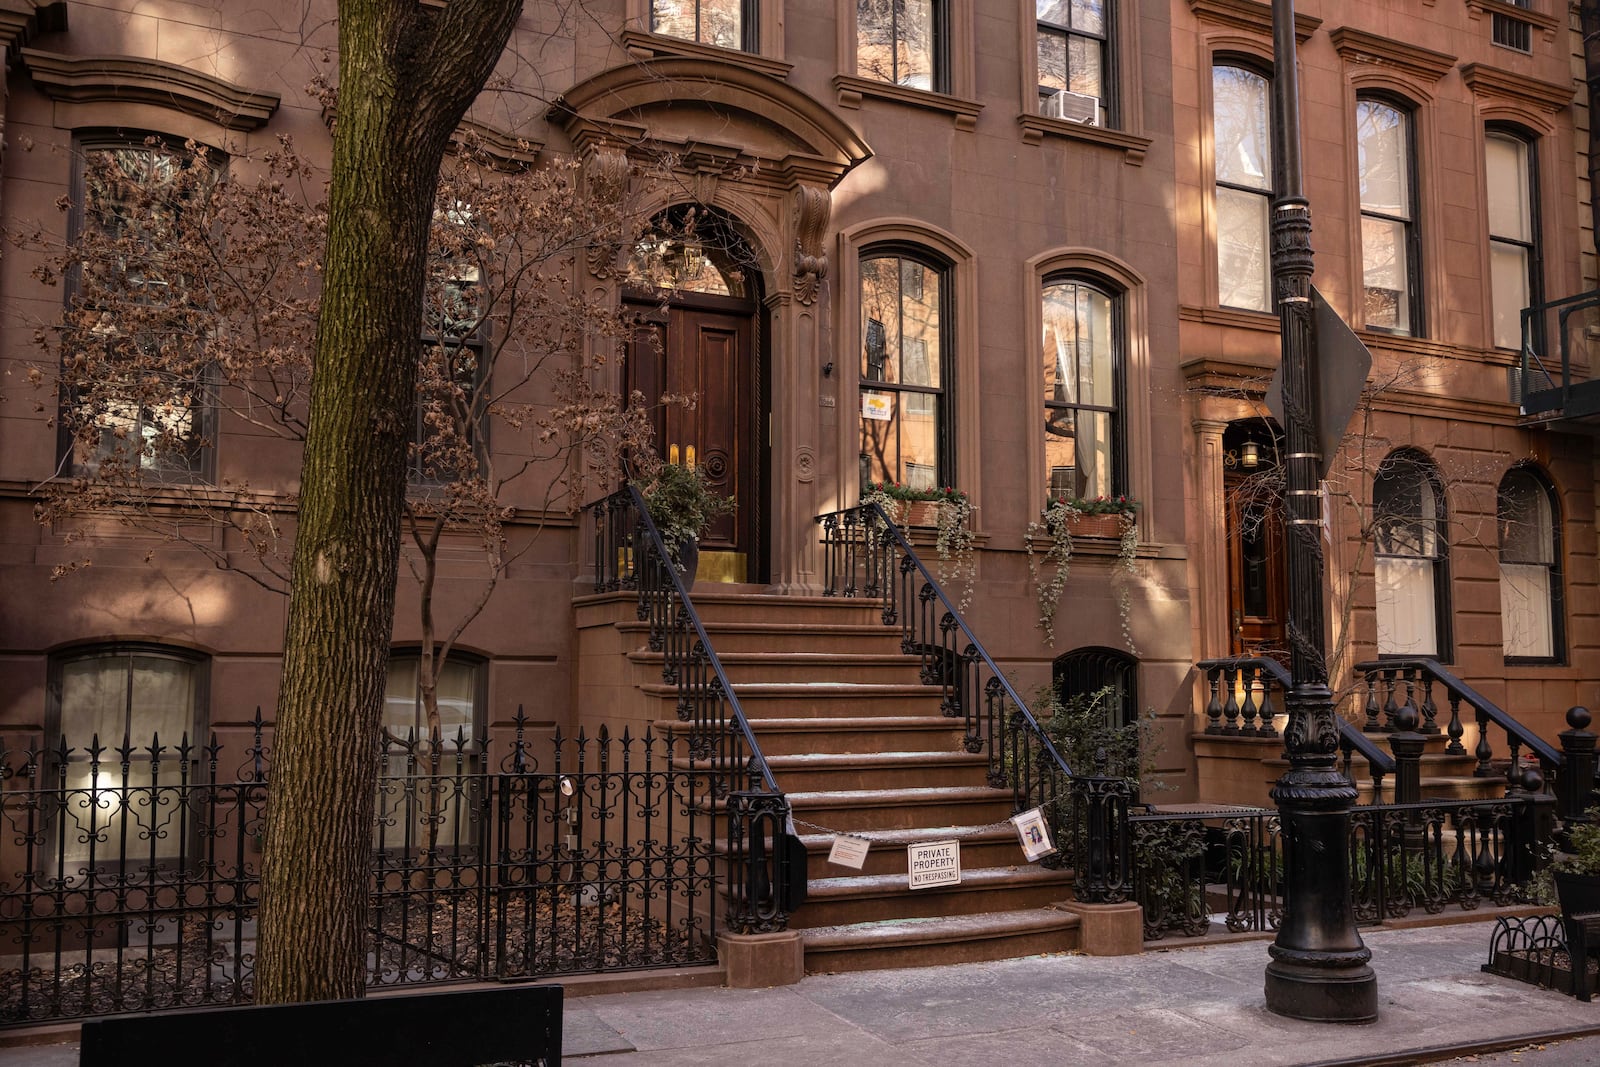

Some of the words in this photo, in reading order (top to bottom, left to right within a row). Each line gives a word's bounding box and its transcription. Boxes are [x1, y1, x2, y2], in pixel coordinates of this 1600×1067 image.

[917, 847, 950, 859] PRIVATE
[914, 857, 955, 870] PROPERTY
[914, 874, 921, 882] NO
[922, 870, 955, 881] TRESPASSING
